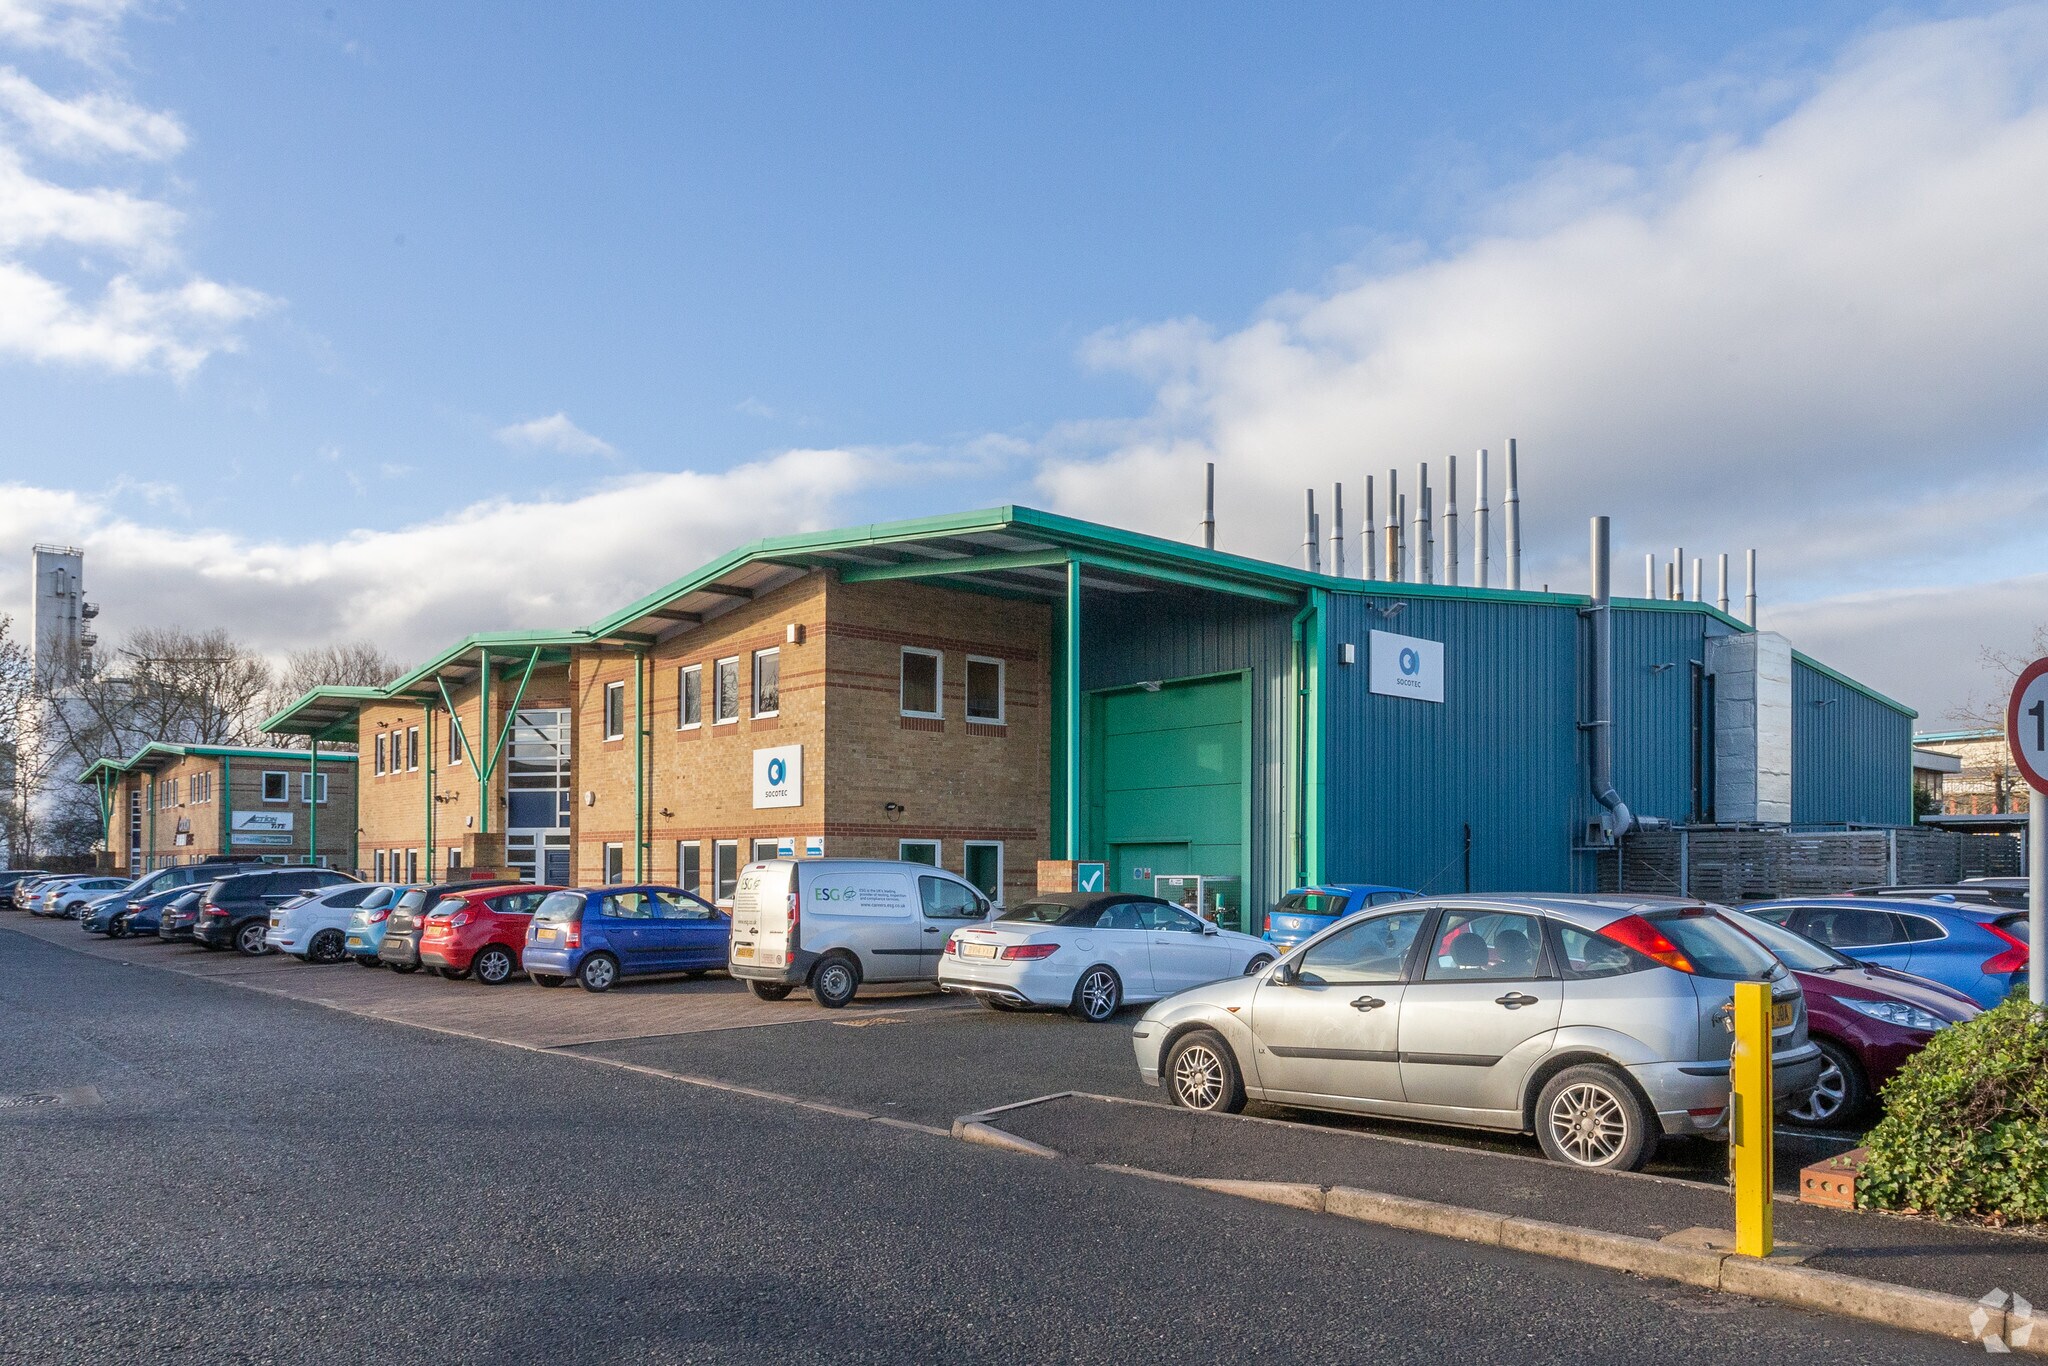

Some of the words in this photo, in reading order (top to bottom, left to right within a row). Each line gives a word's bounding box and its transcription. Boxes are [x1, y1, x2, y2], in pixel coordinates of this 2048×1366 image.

[1396, 678, 1421, 688] SOCOTEC
[765, 789, 788, 798] SOCOTEC
[741, 877, 753, 890] ESG
[815, 887, 840, 901] ESG
